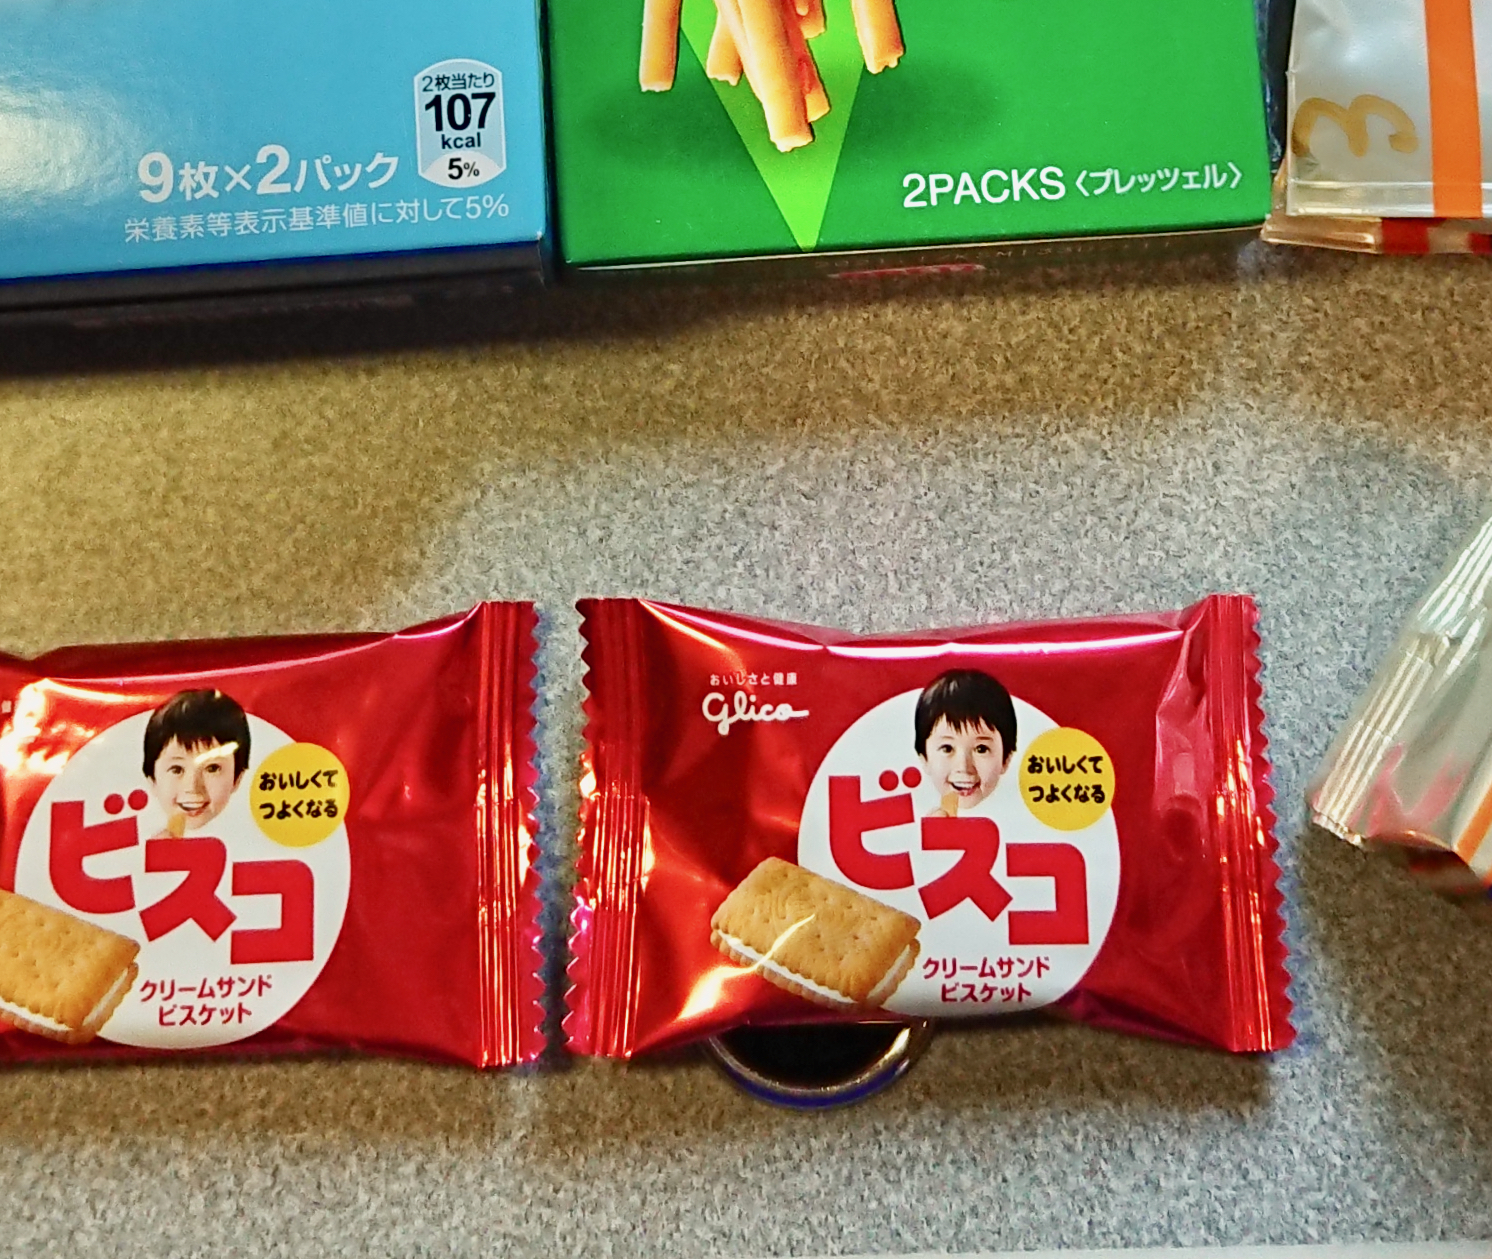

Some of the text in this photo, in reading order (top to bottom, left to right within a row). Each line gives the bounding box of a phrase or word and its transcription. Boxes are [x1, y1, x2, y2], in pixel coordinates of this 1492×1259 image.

[422, 71, 495, 92] 2枚当たり
[424, 91, 496, 132] 107
[441, 132, 481, 149] kcal
[136, 143, 399, 205] 9枚×2パック
[447, 157, 480, 180] 5%
[902, 166, 1066, 208] 2PACKS
[124, 192, 510, 244] 栄養素等表示基準値に対して5%
[708, 670, 799, 688] おいしさと健康
[1026, 752, 1104, 777] おいしくて
[258, 767, 339, 792] おいしくて
[1027, 783, 1107, 806] つよくなる
[258, 797, 339, 821] つよくなる
[827, 769, 1091, 947] ビスコ
[48, 788, 315, 966] ビスコ
[921, 954, 1052, 981] クリームサンド
[139, 973, 274, 1004] クリームサンド
[940, 980, 1034, 1005] ビスケット
[158, 1002, 253, 1028] ビスケット
